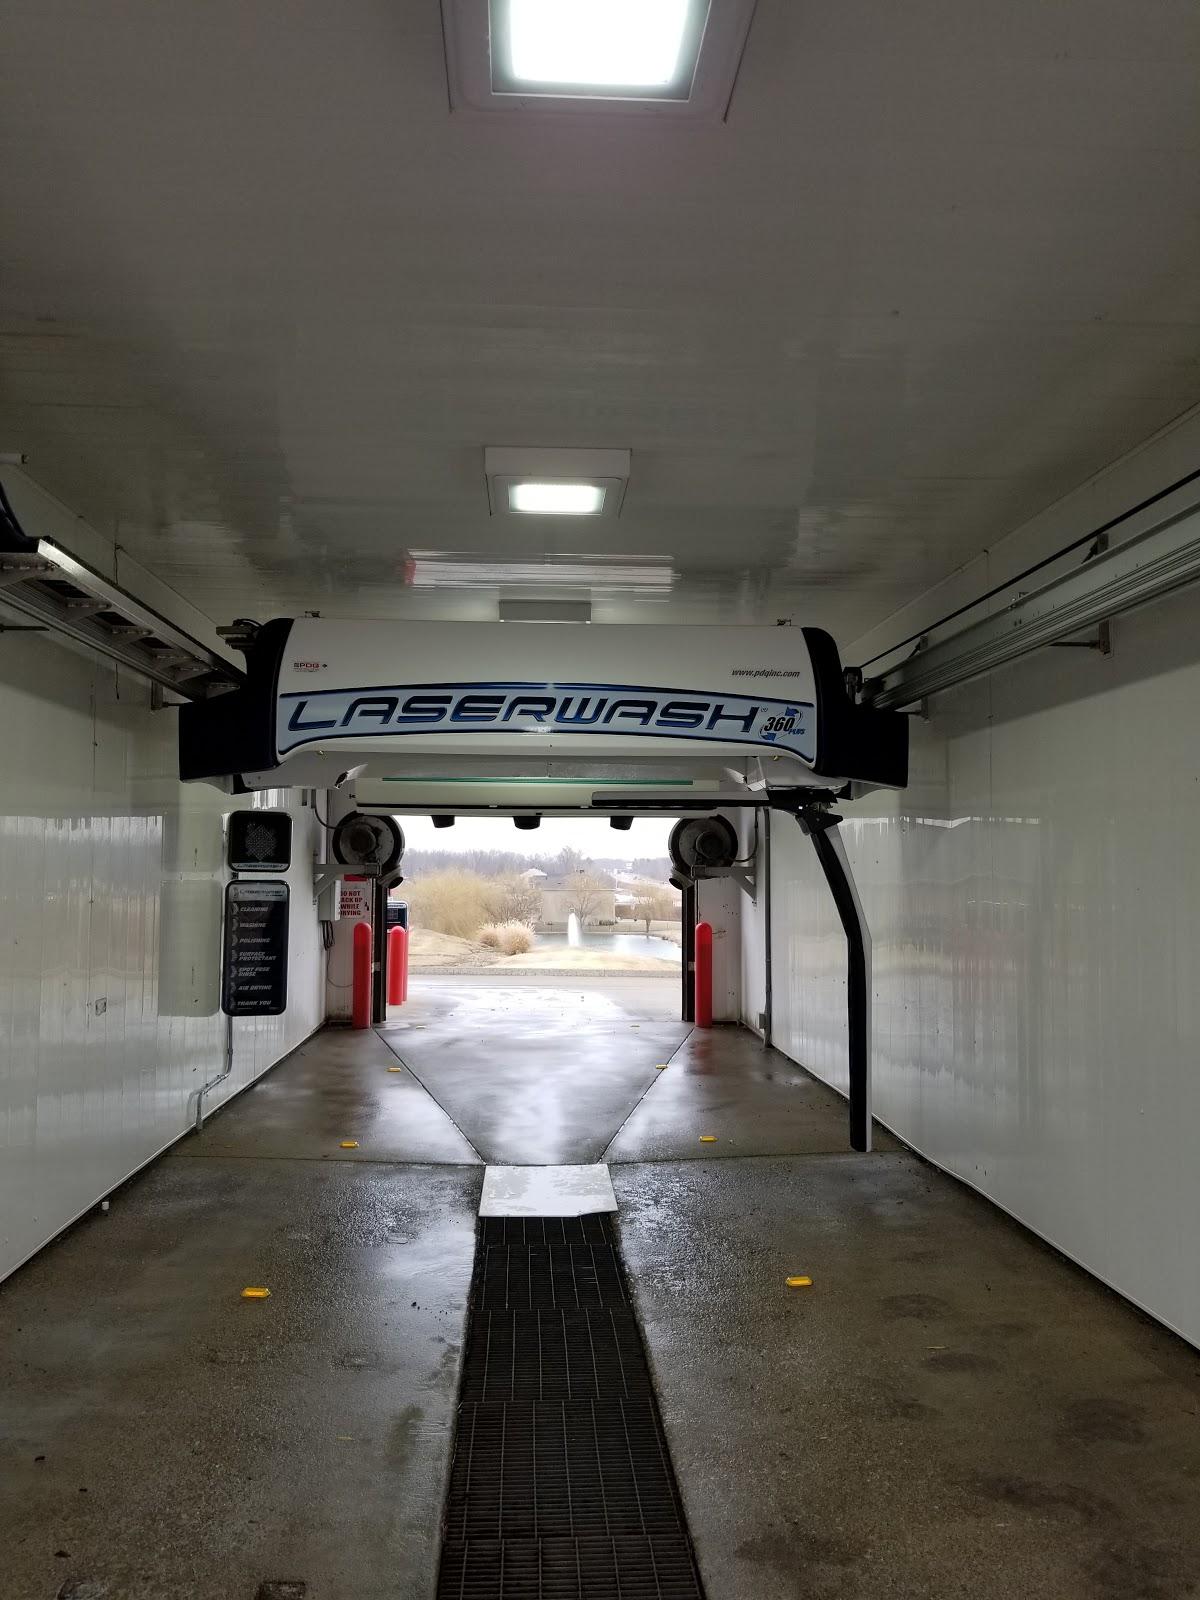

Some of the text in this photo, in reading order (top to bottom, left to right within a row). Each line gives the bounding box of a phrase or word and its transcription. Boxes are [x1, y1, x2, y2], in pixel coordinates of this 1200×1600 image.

[731, 669, 801, 678] www.pdqinc.com
[764, 716, 796, 732] 360
[788, 728, 806, 736] PLUS
